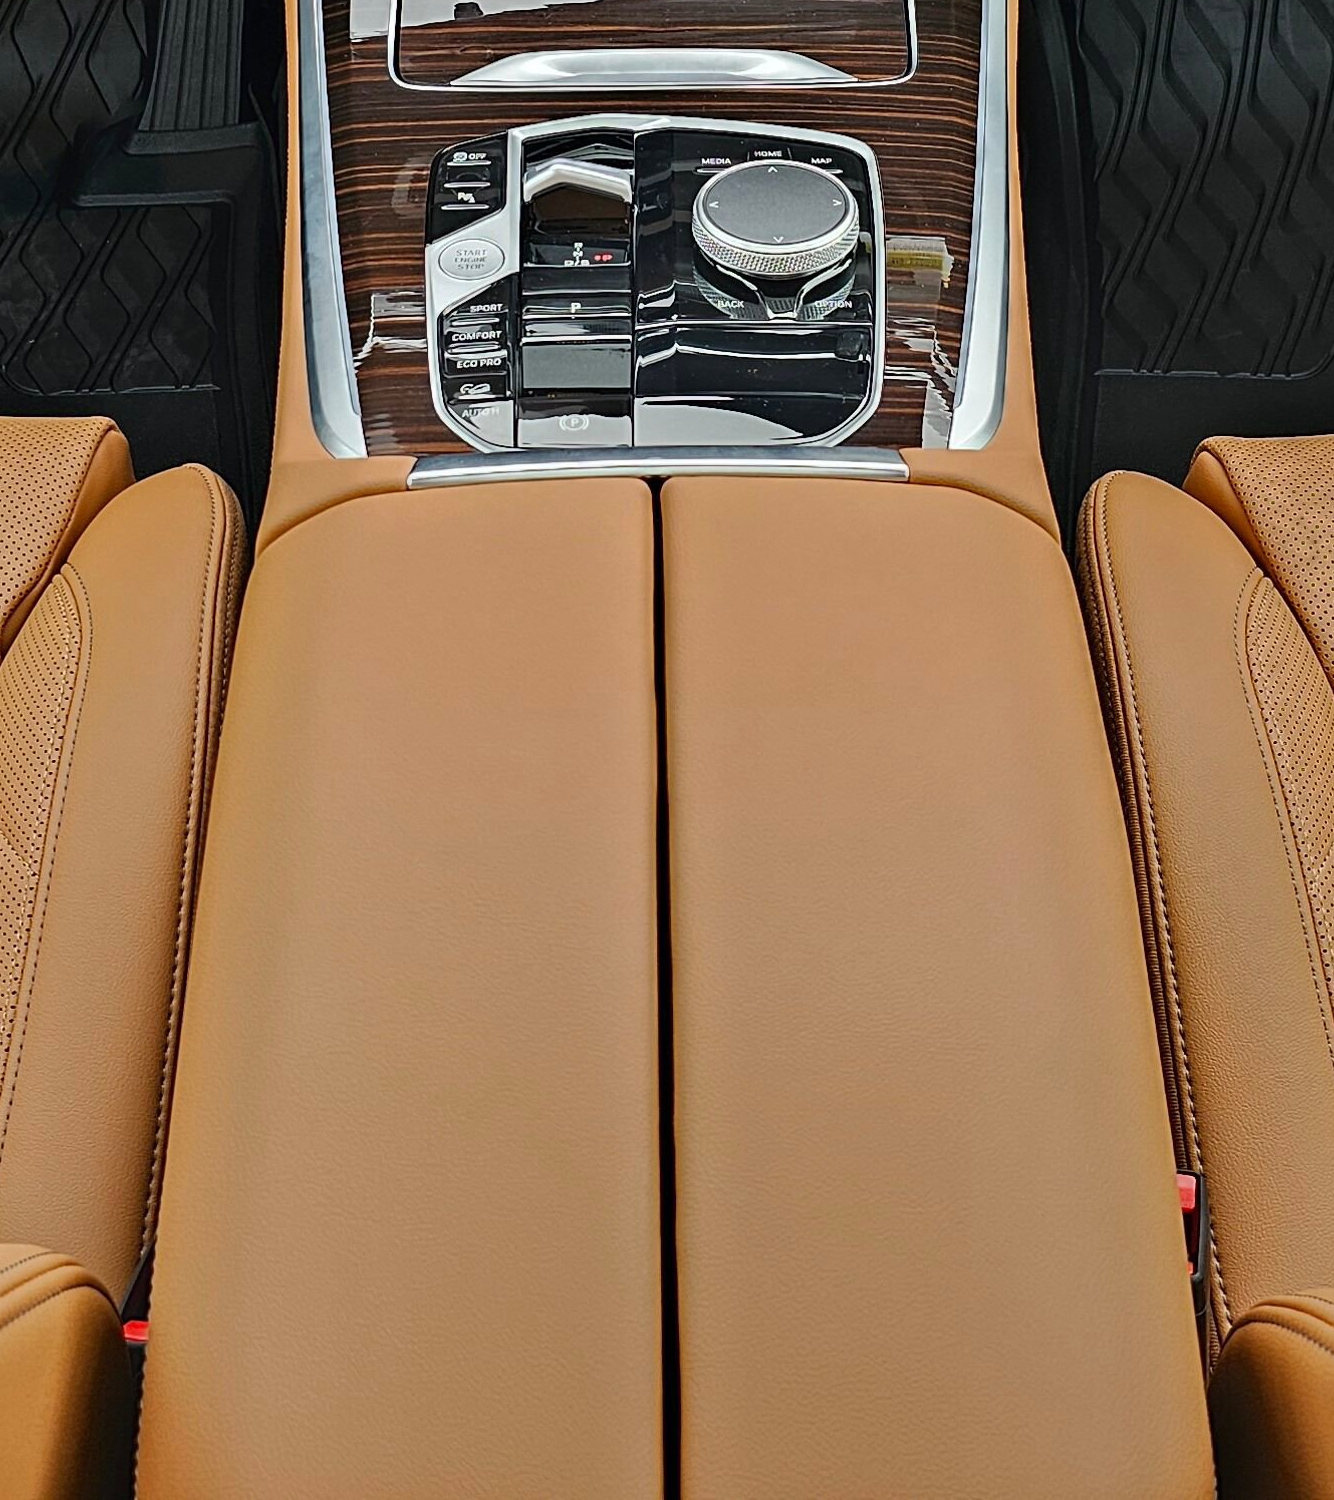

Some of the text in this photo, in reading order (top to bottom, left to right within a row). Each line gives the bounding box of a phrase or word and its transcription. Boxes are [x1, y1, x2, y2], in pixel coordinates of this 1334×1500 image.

[701, 157, 732, 165] MEDIA
[470, 304, 503, 312] SPORT
[571, 303, 581, 313] P
[717, 300, 744, 308] BACK
[815, 300, 853, 308] OPTION
[452, 331, 502, 342] COMFORT
[457, 358, 502, 369] ECO PRO
